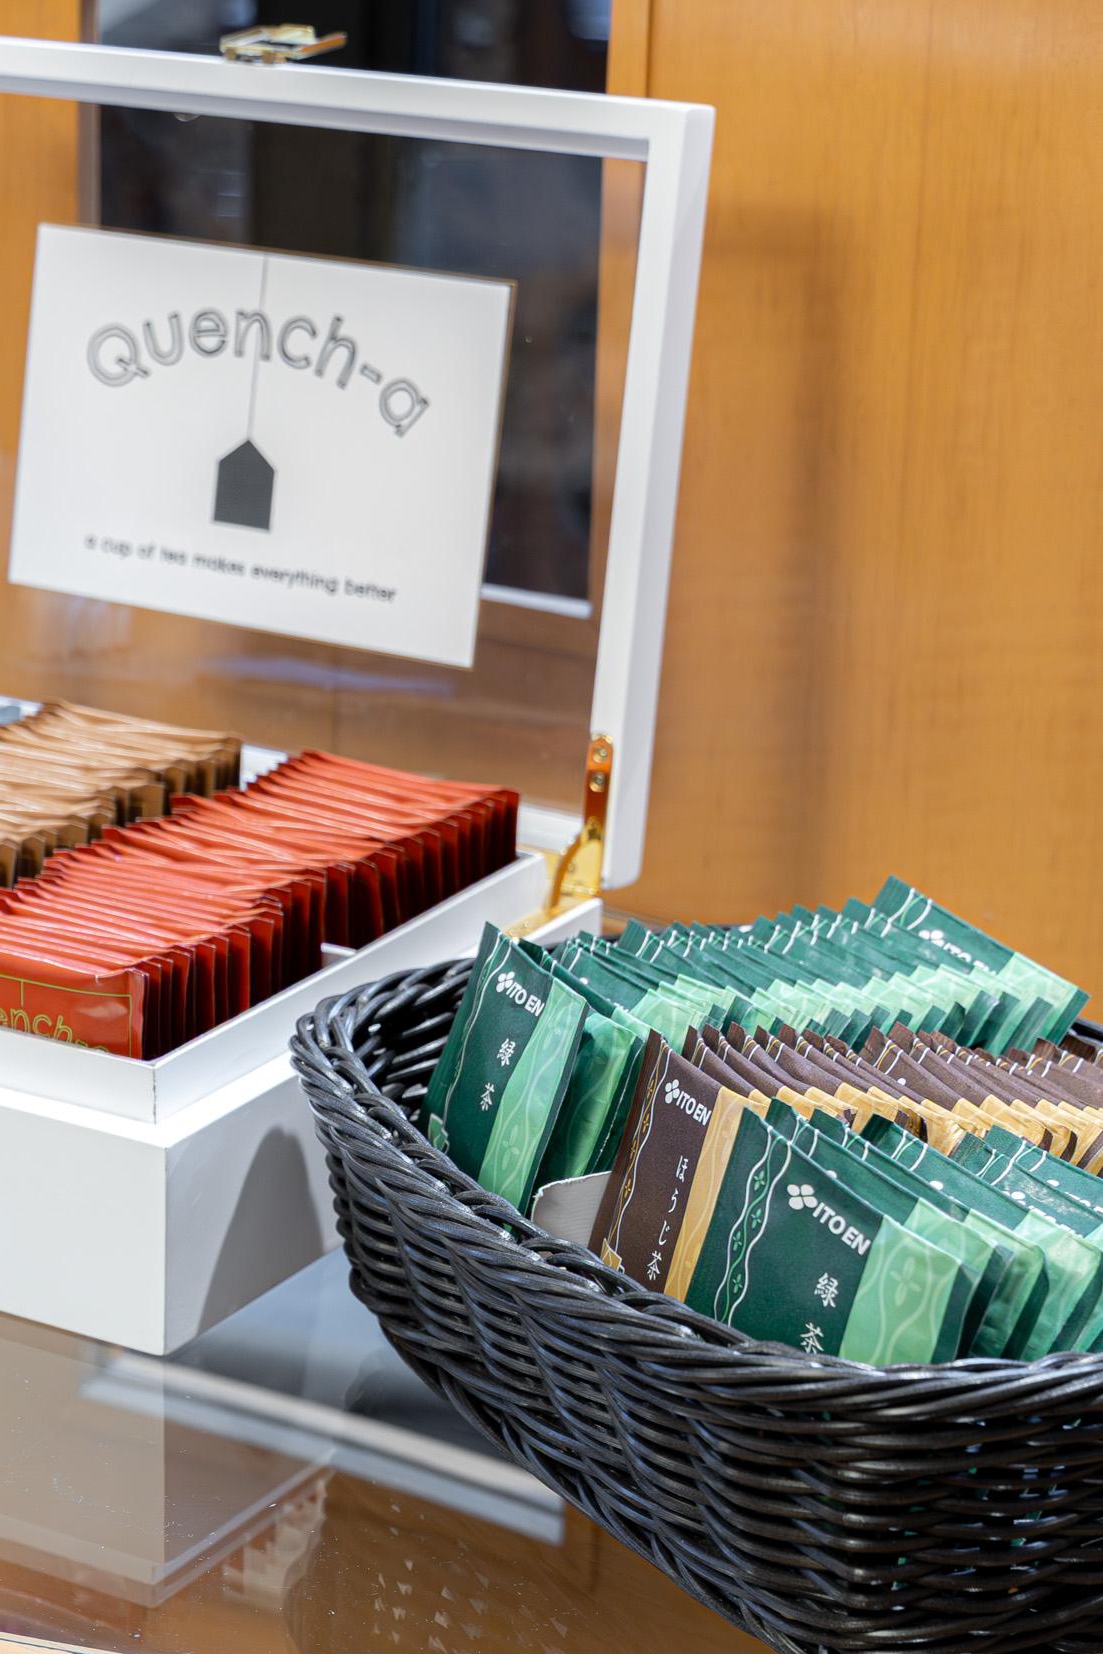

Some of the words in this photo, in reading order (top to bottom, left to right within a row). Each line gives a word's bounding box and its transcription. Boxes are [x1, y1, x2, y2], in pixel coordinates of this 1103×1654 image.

[86, 306, 430, 438] Quench-a
[252, 563, 338, 595] everything
[646, 1155, 689, 1281] ほうじ茶
[800, 1272, 840, 1353] 緑茶
